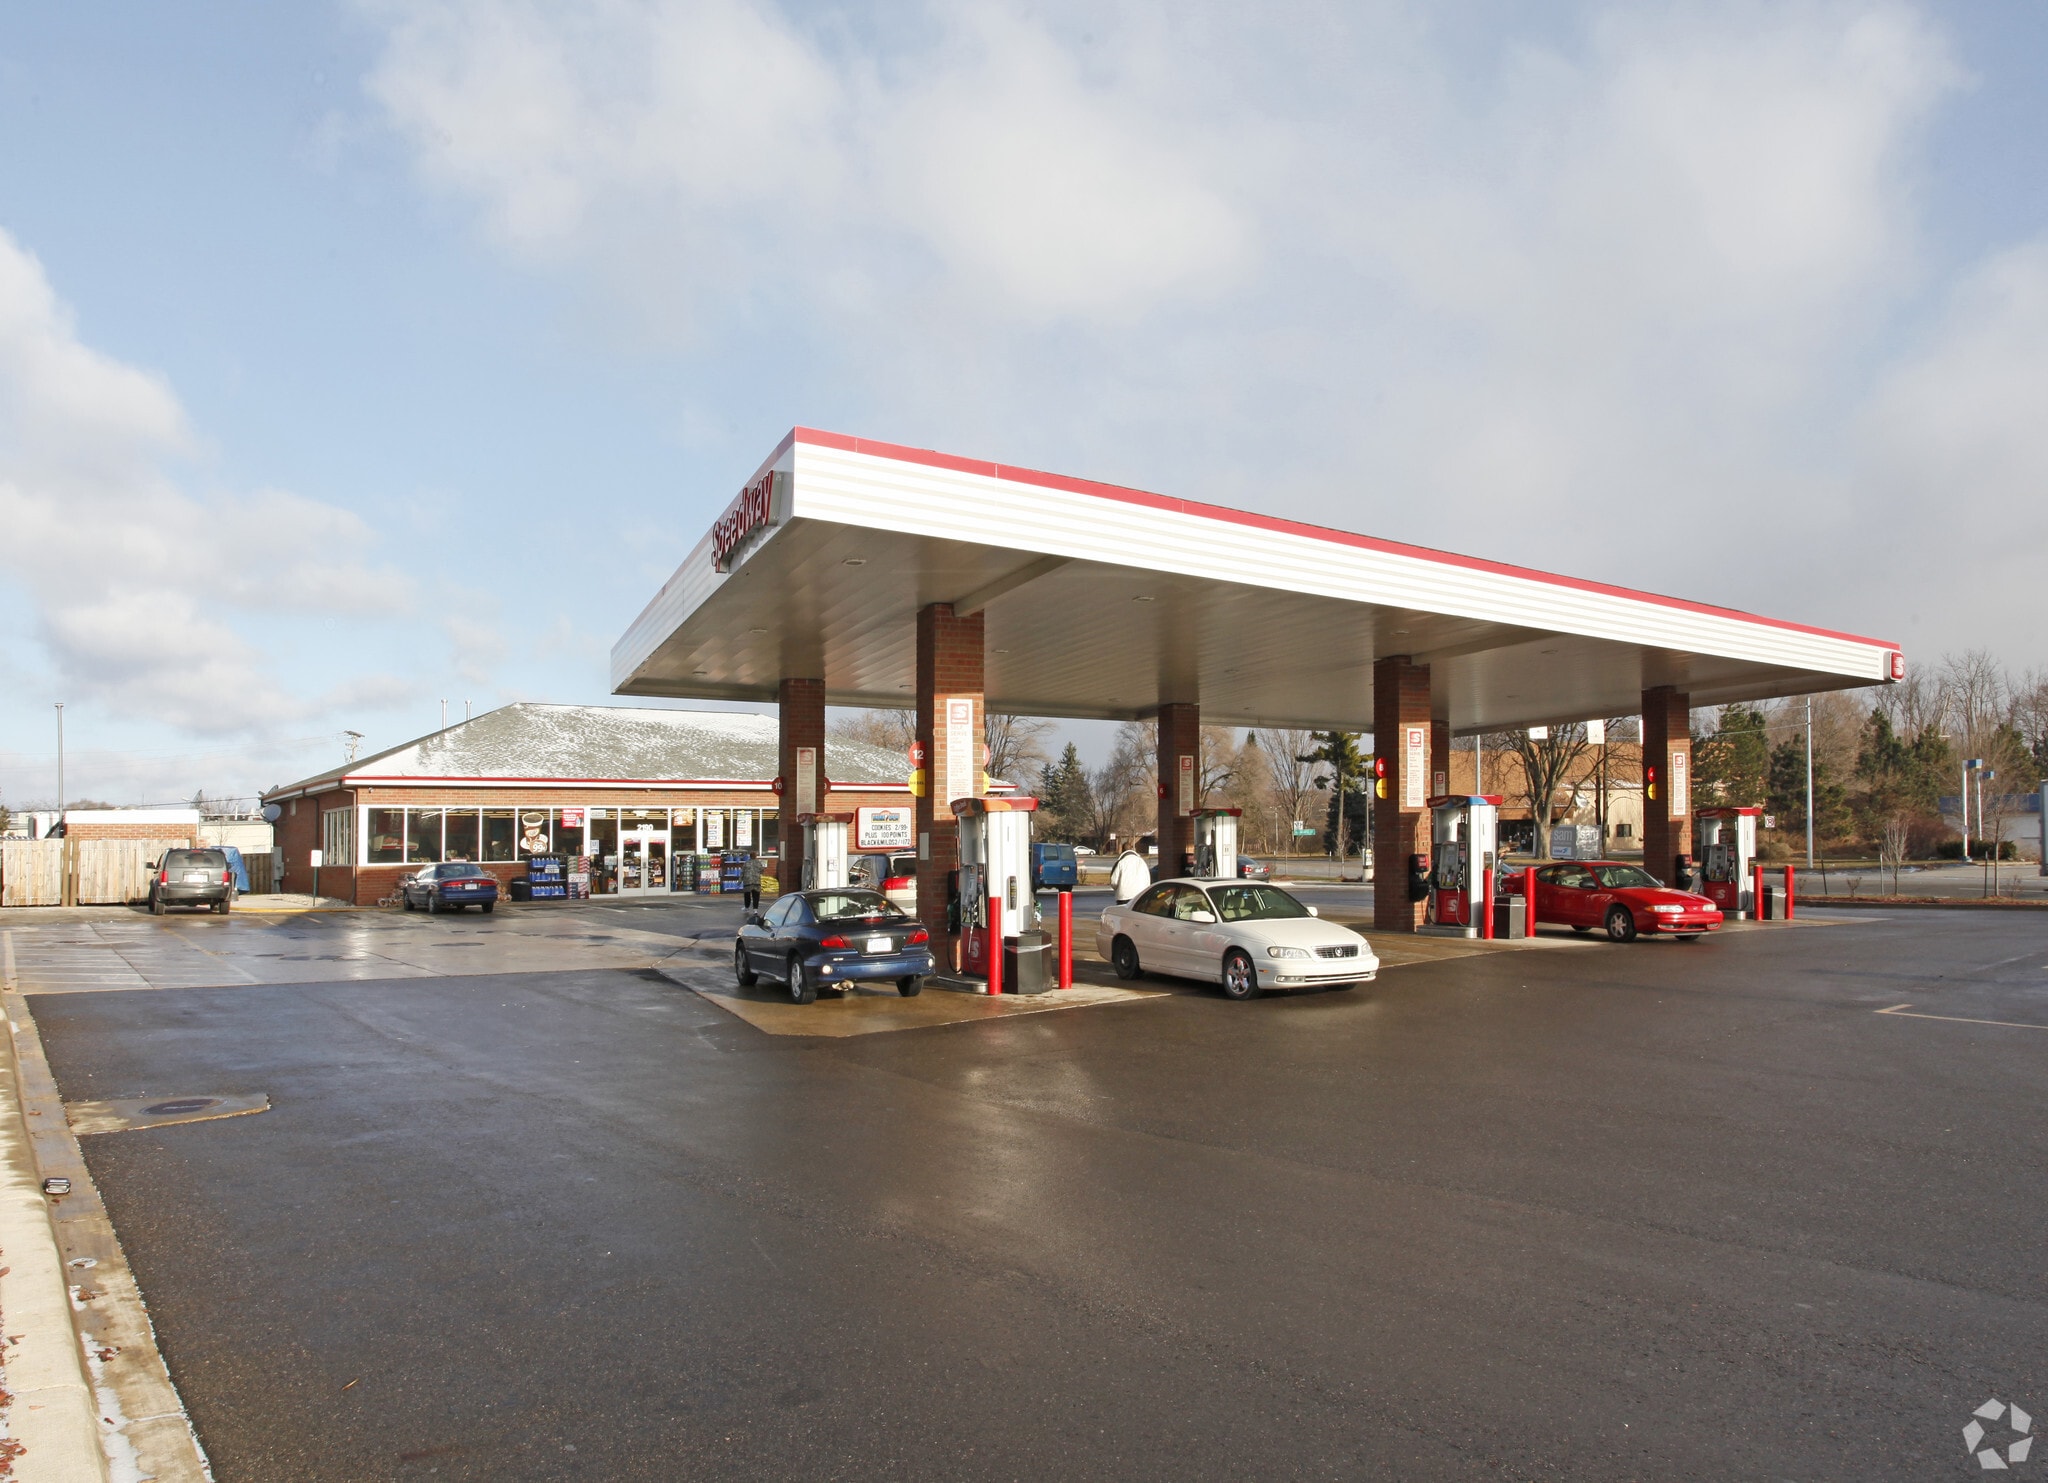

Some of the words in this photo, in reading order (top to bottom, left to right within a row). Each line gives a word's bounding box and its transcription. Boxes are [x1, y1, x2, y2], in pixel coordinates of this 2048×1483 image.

[711, 470, 775, 574] Speedway
[912, 749, 924, 760] 12
[774, 782, 783, 790] 10
[1553, 830, 1573, 841] sam
